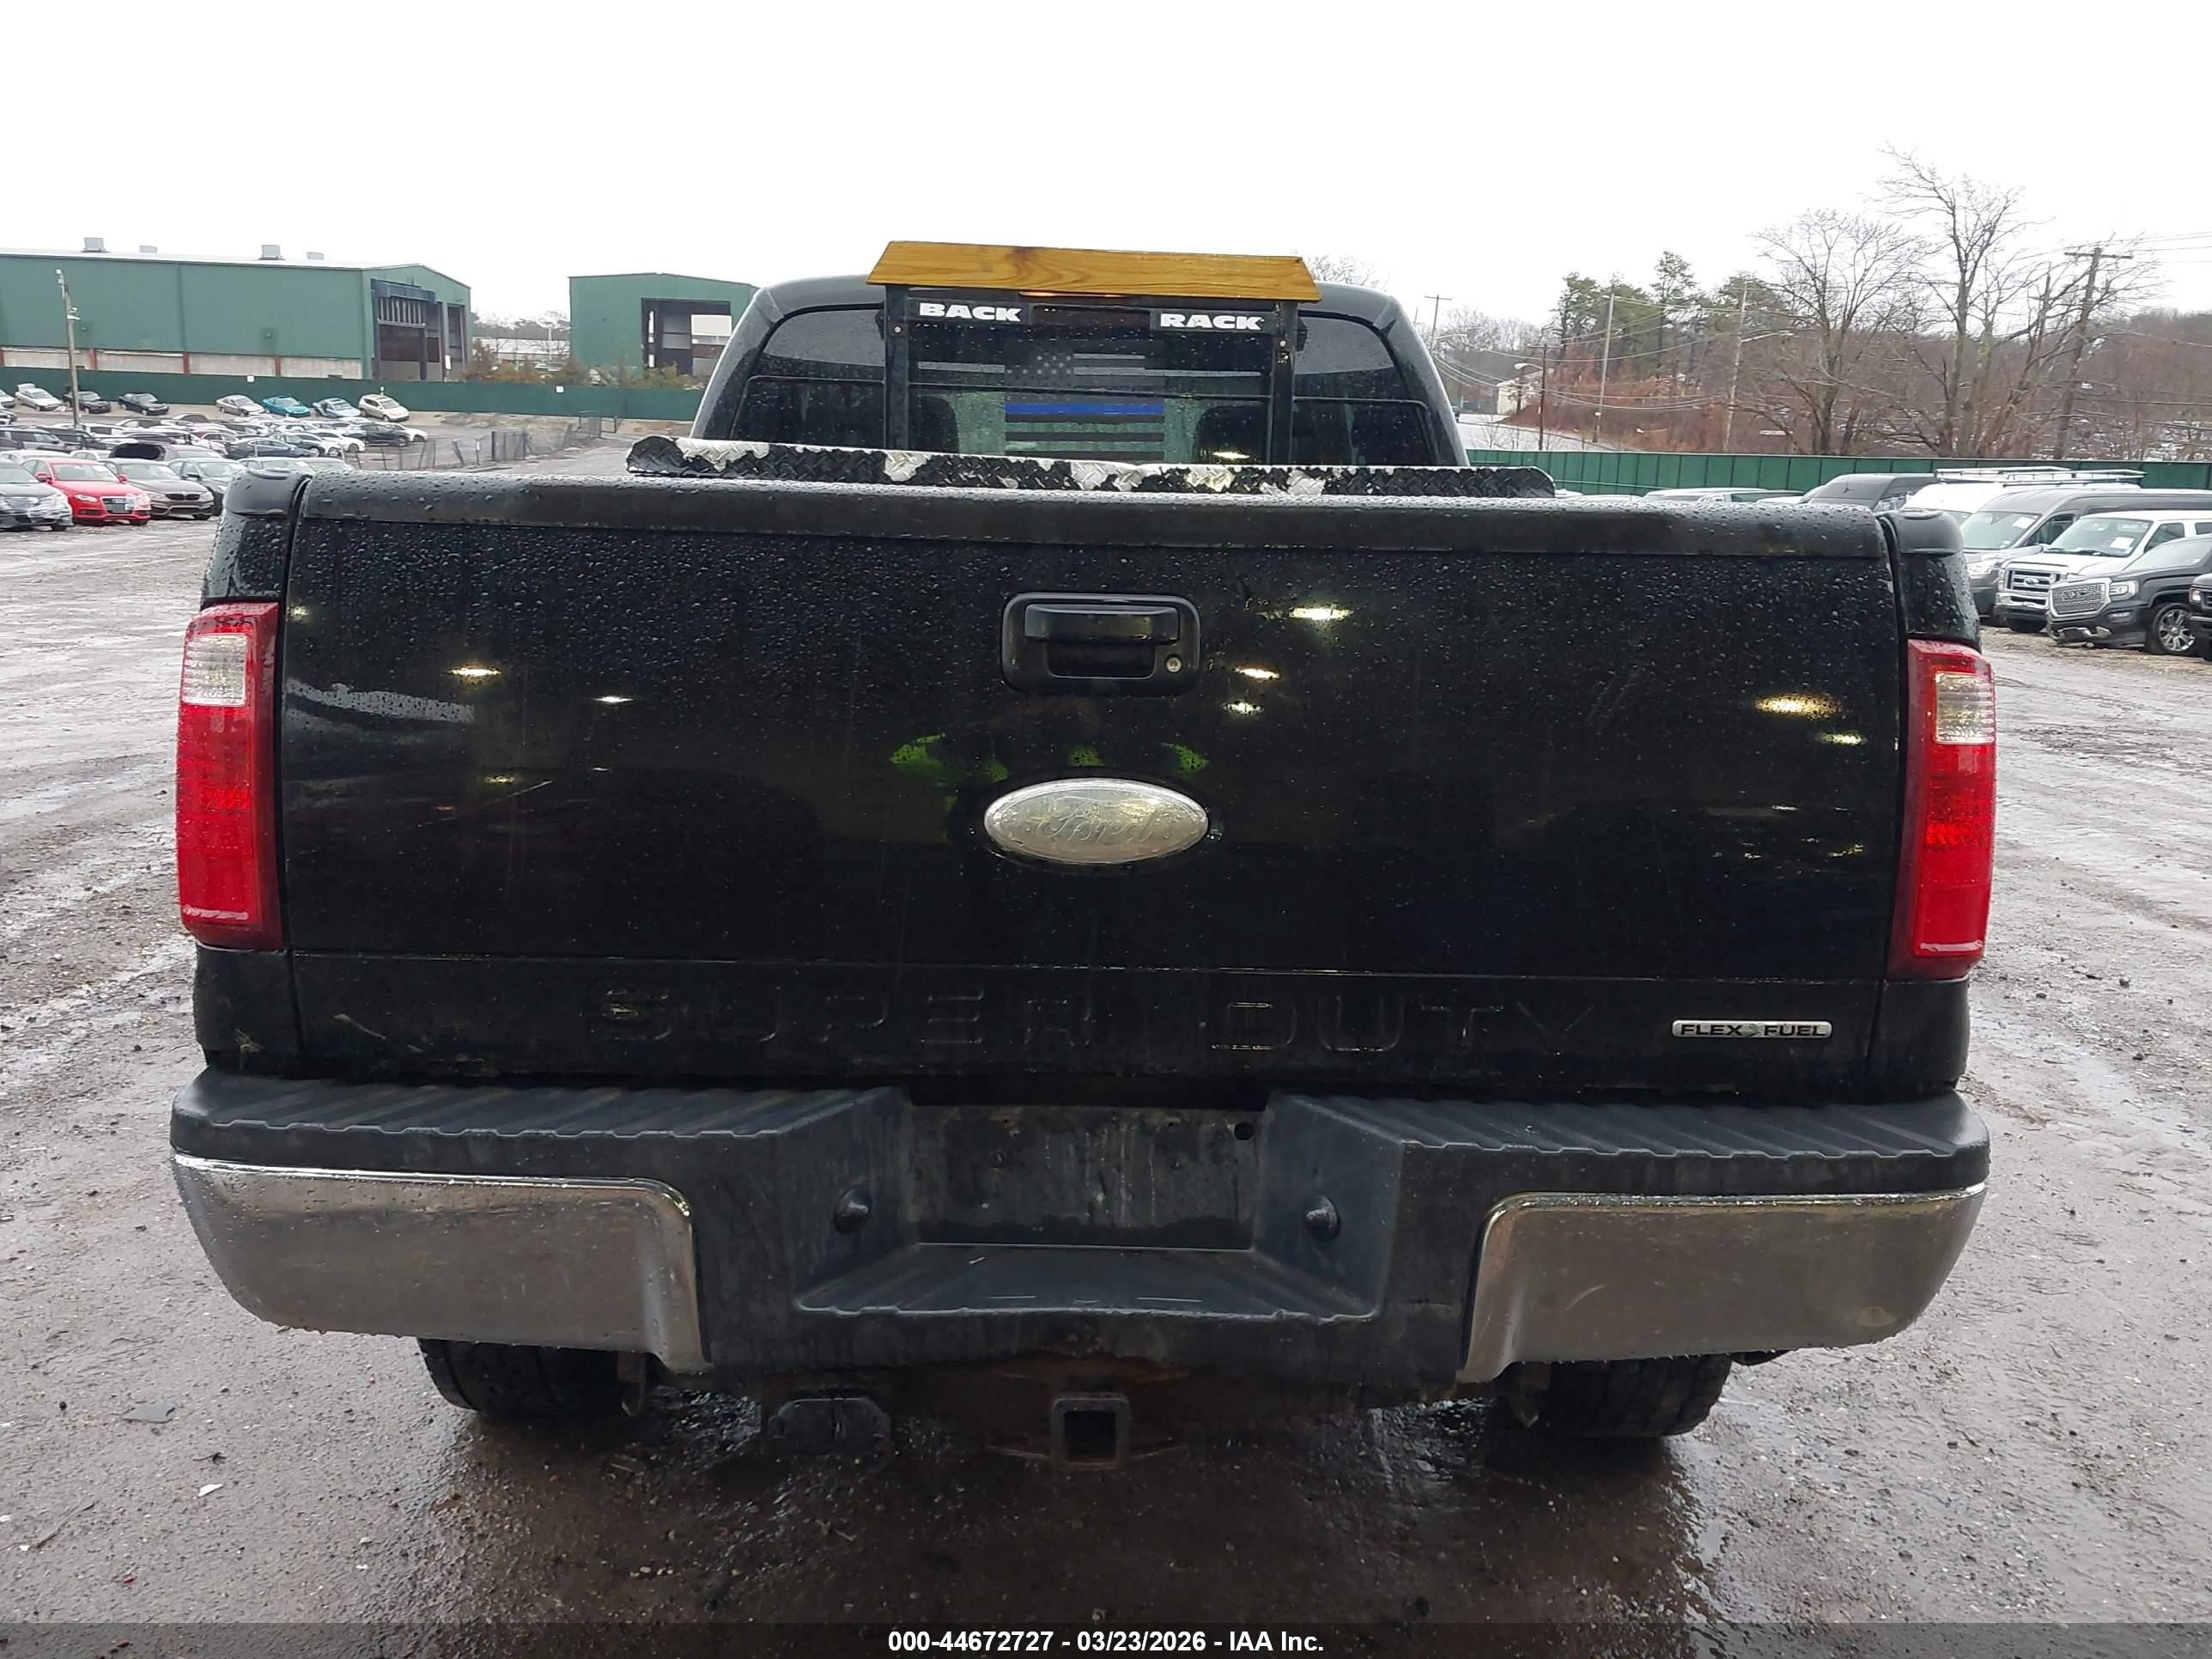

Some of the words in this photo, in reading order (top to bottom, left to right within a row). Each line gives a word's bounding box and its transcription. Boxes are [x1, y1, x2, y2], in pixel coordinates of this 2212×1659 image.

[920, 302, 1023, 322] BACK
[1160, 313, 1262, 331] RACK
[589, 982, 1094, 1048] SUPER
[1680, 1024, 1743, 1036] FLEX
[1763, 1024, 1826, 1037] FUEL
